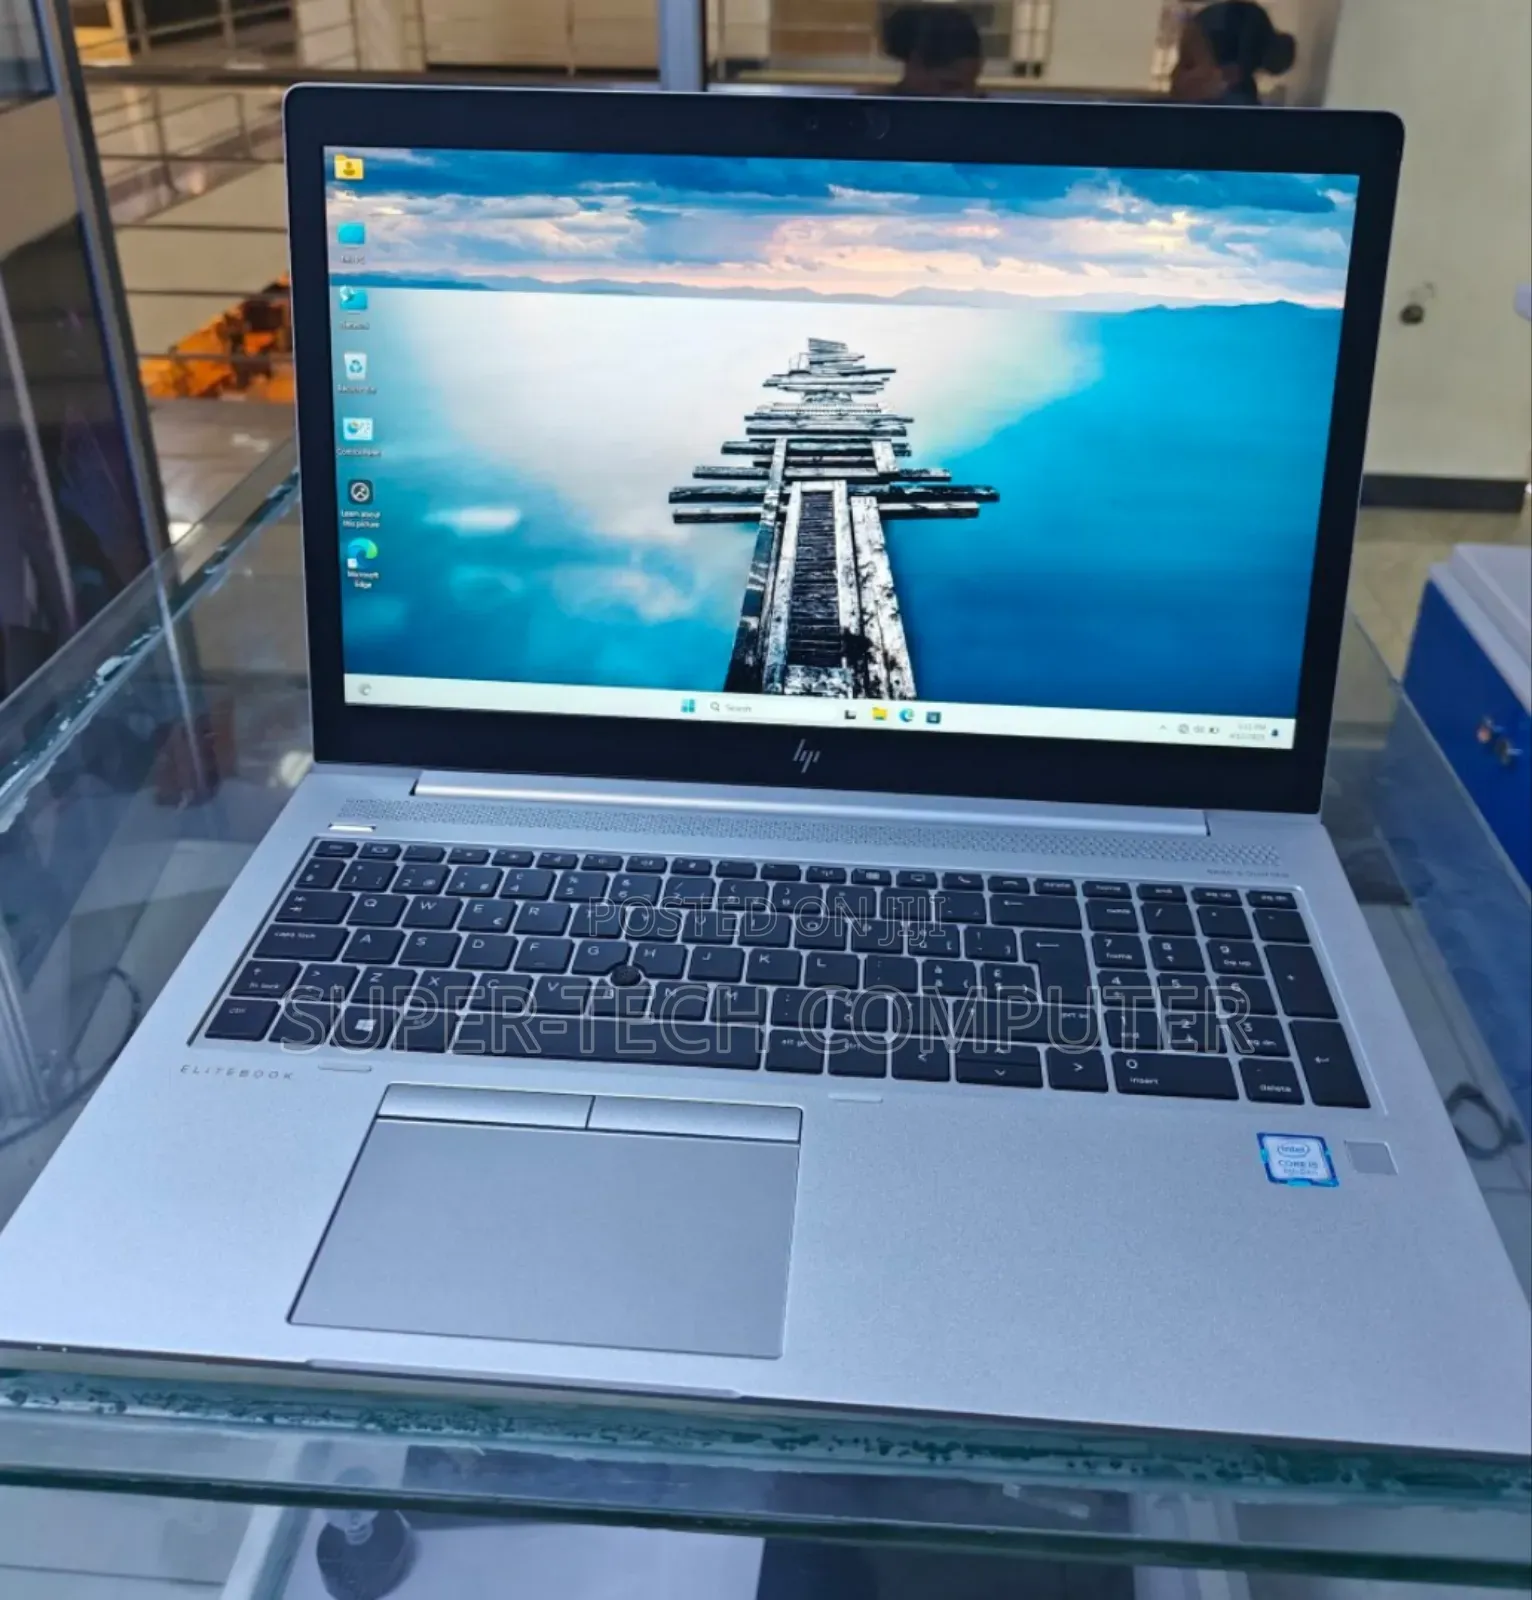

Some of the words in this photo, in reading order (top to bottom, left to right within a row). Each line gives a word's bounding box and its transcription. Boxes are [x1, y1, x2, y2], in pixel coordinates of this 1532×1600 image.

[793, 738, 821, 774] hp
[363, 898, 378, 908] Q
[419, 901, 437, 911] W
[472, 904, 485, 914] E
[528, 907, 540, 917] R
[806, 921, 820, 932] O
[359, 934, 372, 944] A
[415, 936, 428, 947] S
[471, 939, 485, 949] D
[529, 942, 541, 952] F
[587, 945, 600, 956] G
[643, 949, 656, 958] H
[702, 952, 712, 962] J
[758, 954, 771, 964] K
[816, 957, 827, 968] L
[369, 972, 383, 983] Z
[427, 976, 441, 987] X
[487, 979, 500, 989] C
[547, 982, 559, 992] V
[180, 1064, 294, 1080] ELITEBOOK
[1130, 1076, 1159, 1085] insert
